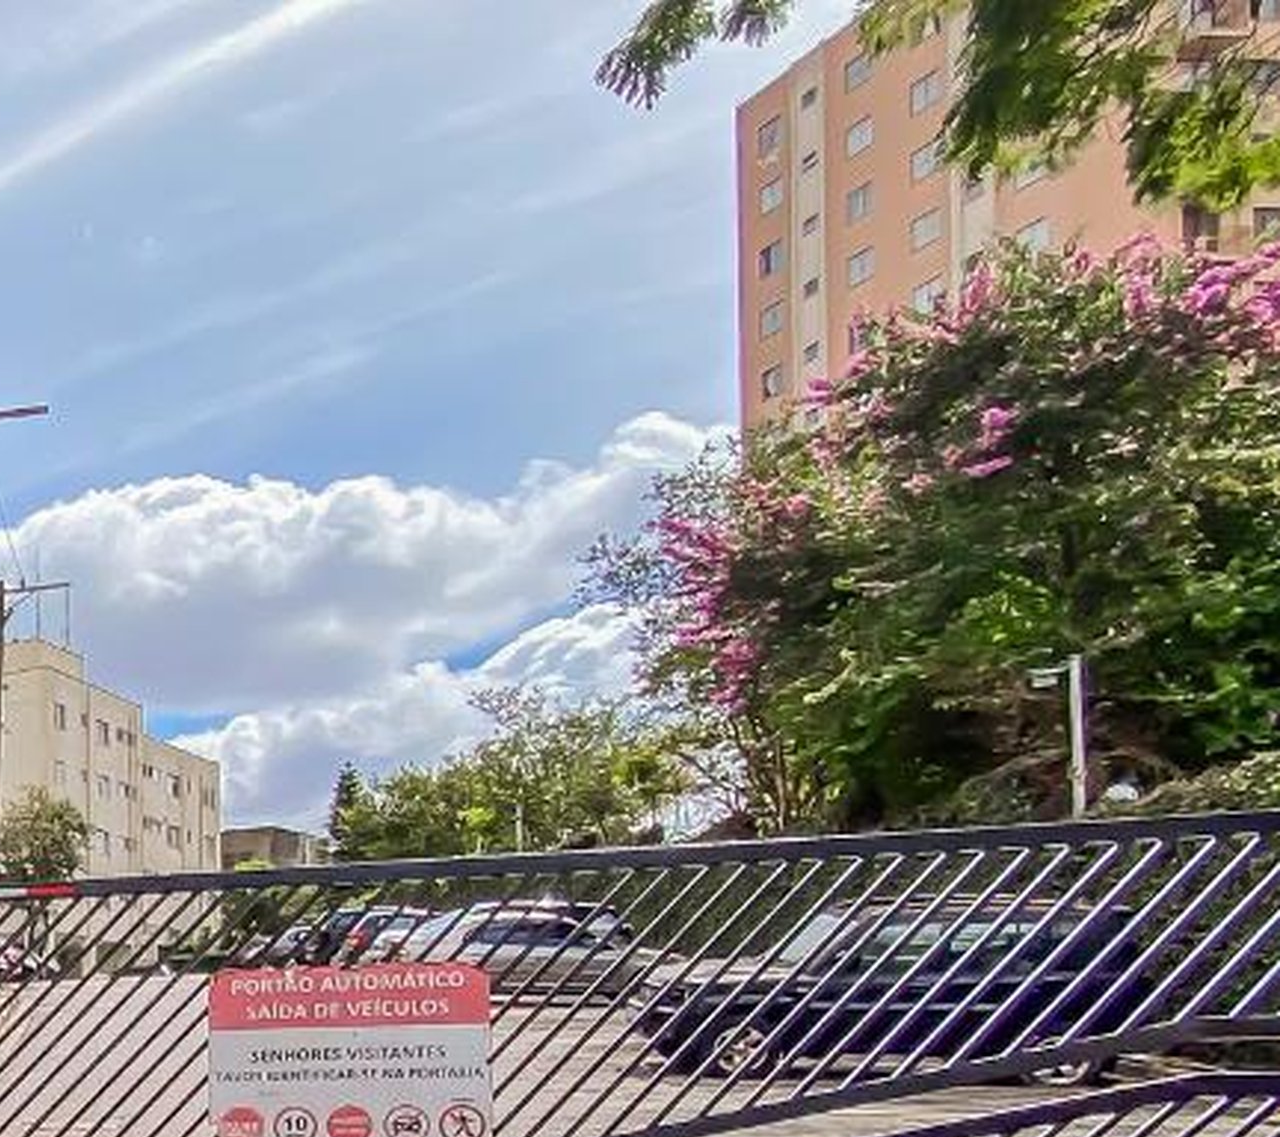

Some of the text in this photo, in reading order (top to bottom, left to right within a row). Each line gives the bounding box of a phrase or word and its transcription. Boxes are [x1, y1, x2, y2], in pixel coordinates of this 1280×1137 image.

[231, 970, 465, 996] PORTÃO AUTOMÁTICO
[246, 997, 449, 1021] SAÍDA DE VEÍCULOS
[251, 1044, 446, 1063] SENHORES VISITANTES
[285, 1116, 308, 1131] 10
